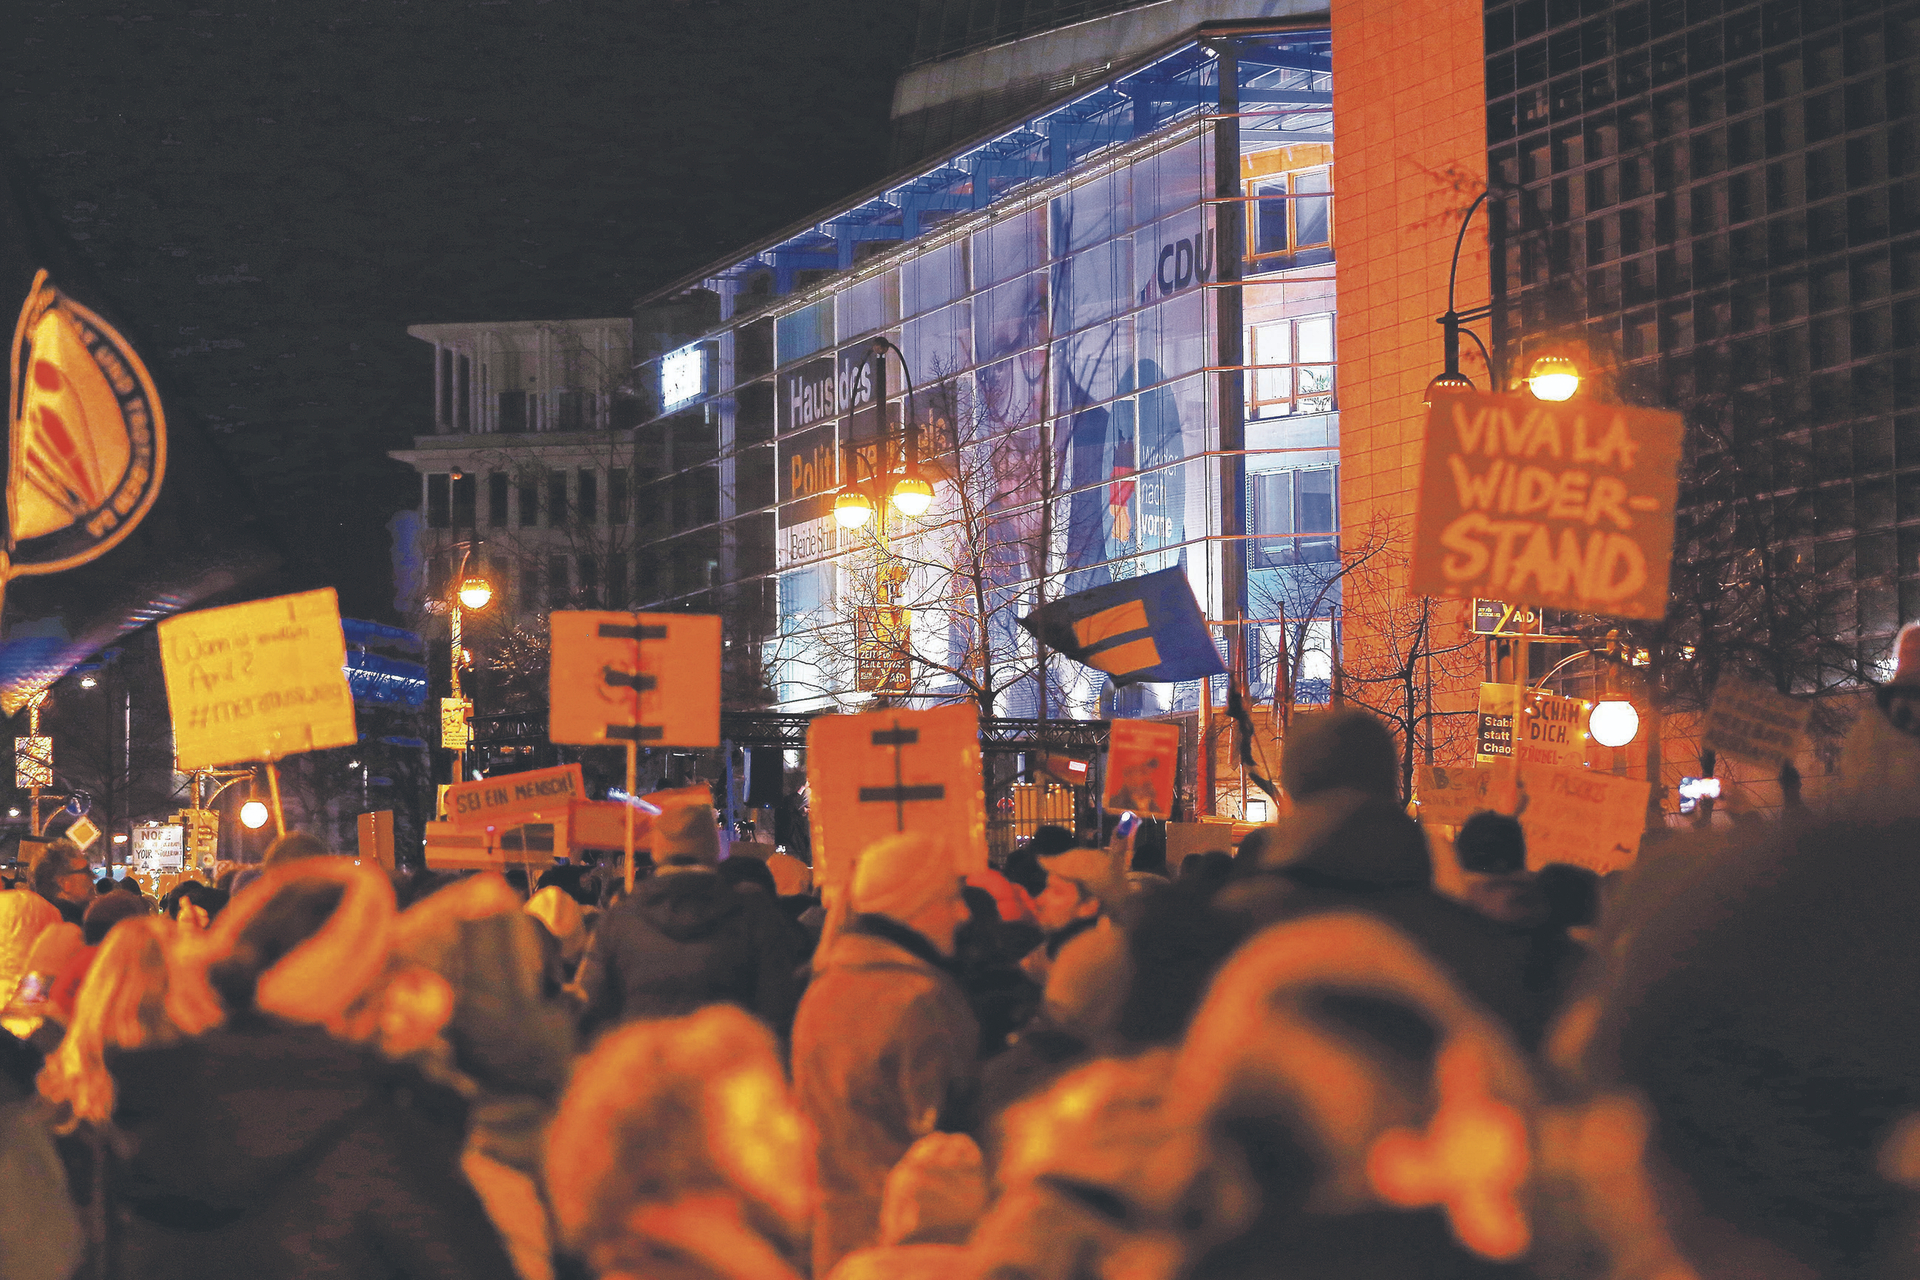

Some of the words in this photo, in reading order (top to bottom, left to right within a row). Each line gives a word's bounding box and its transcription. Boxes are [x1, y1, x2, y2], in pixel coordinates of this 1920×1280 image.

[1157, 227, 1215, 297] CDU
[790, 376, 835, 429] Haus
[838, 357, 872, 411] des
[1452, 401, 1564, 457] VIVA
[1573, 413, 1640, 470] LA
[1140, 479, 1166, 506] nach
[1448, 453, 1660, 530] WIDER-
[1140, 513, 1173, 539] vorne
[790, 527, 817, 561] Beide
[1441, 511, 1648, 602] STAND
[889, 672, 907, 683] AfD
[1528, 700, 1581, 724] SCHAM
[1483, 730, 1511, 741] statt
[1483, 743, 1517, 755] Chaos
[1530, 722, 1570, 746] DICH,
[456, 792, 482, 814] SEI
[484, 787, 509, 808] EIN
[514, 771, 578, 801] MENSCH!
